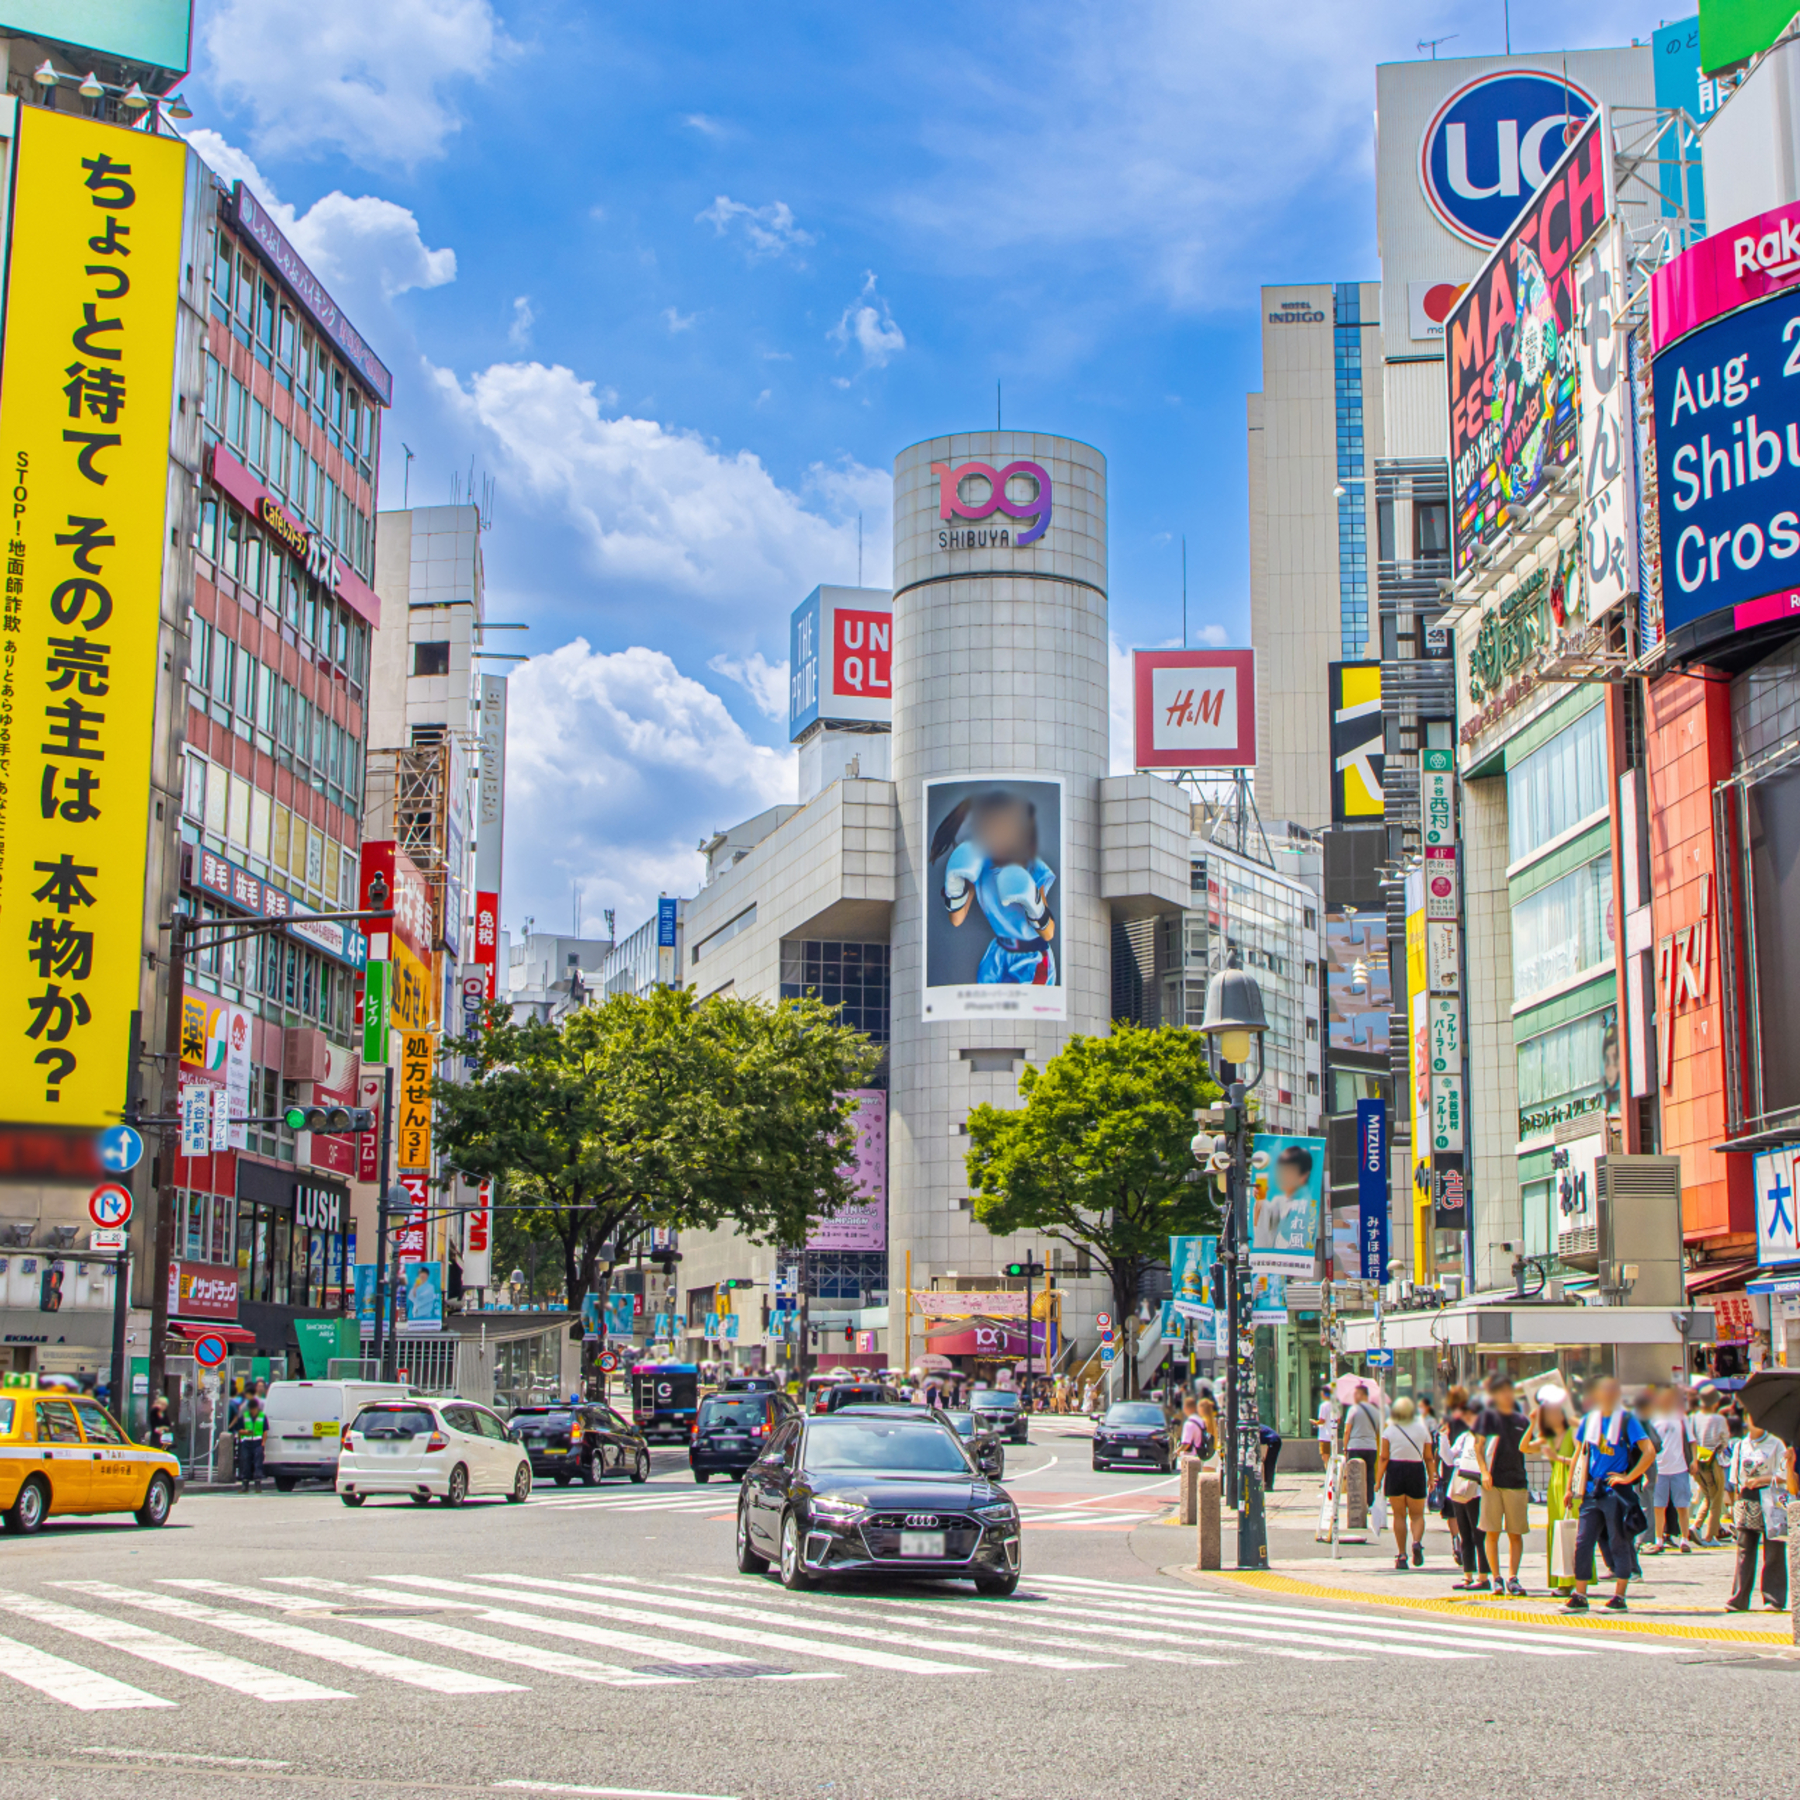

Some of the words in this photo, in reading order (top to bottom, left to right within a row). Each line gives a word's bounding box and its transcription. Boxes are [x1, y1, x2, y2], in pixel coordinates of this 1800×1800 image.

[1734, 218, 1800, 278] Rak
[62, 153, 136, 487] ちょっと待て
[1269, 311, 1325, 323] INDIGO
[1281, 301, 1311, 309] HOTEL
[1670, 352, 1760, 427] Aug.
[1511, 388, 1541, 453] tinder
[1581, 247, 1625, 592] もんじゃ
[930, 460, 1052, 546] 109
[938, 529, 1010, 548] SHIBUYA
[306, 534, 341, 593] ガスト
[797, 611, 813, 667] THE
[843, 620, 889, 652] UN
[41, 514, 116, 822] その売主は
[843, 656, 892, 691] QL
[1166, 688, 1225, 728] H&M
[1430, 776, 1449, 829] 渋谷西村
[1433, 848, 1448, 859] 4F
[204, 854, 228, 896] 薄毛
[235, 872, 258, 909] 抜毛
[346, 933, 366, 966] 4F
[477, 910, 495, 945] 免税
[366, 994, 379, 1026] レイク
[463, 980, 482, 1011] OS
[182, 1003, 205, 1060] 薬
[1433, 1019, 1445, 1056] パーラー
[1446, 1013, 1457, 1051] フルーツ
[404, 1038, 429, 1128] 処方せん
[193, 1090, 206, 1150] 渋谷駅前
[1436, 1095, 1447, 1134] フルーツ
[1449, 1090, 1459, 1130] 渋谷西村
[408, 1131, 422, 1163] 3F
[1367, 1114, 1381, 1173] MIZUHO
[296, 1184, 341, 1233] LUSH
[1441, 1168, 1464, 1211] HUB
[1767, 1172, 1793, 1239] 大
[823, 1217, 869, 1225] CAMPAIGN
[1366, 1216, 1380, 1278] みずほ銀行
[197, 1278, 237, 1302] サンドラッグ
[4, 1334, 49, 1342] EKIMAE
[306, 1323, 335, 1331] SMOKING
